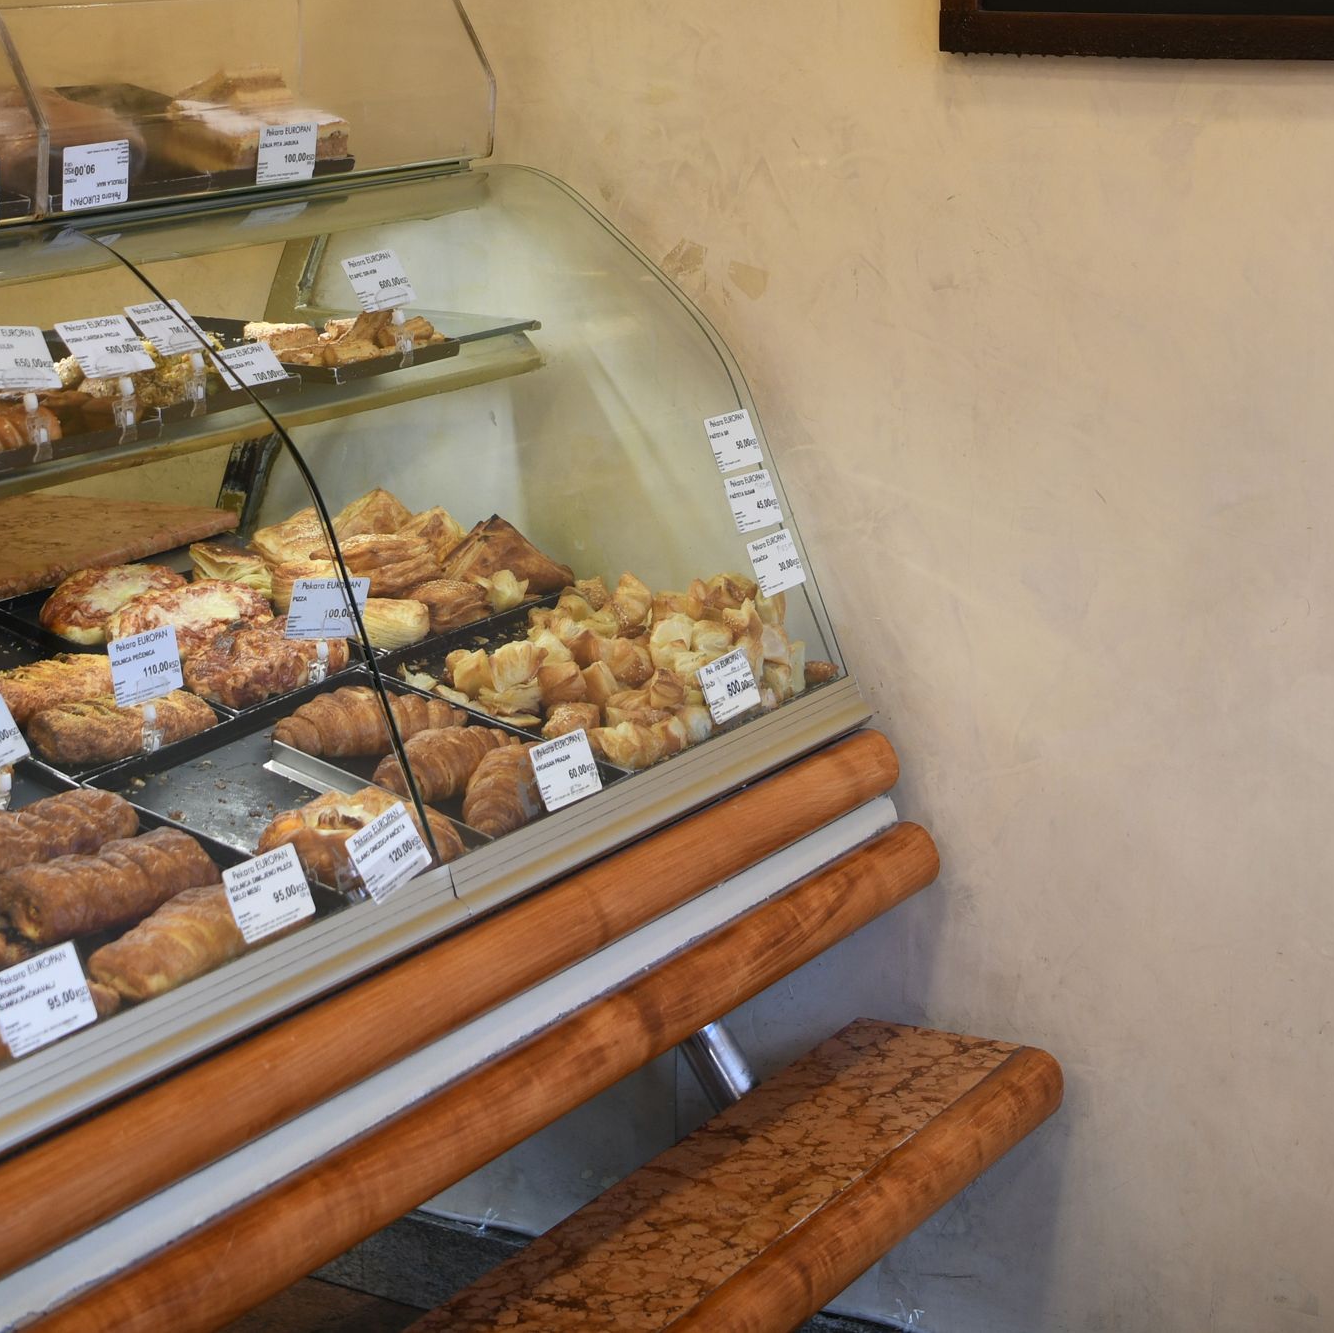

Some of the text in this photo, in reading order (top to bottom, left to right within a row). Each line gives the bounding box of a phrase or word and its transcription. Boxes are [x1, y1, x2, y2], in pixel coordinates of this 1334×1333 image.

[284, 125, 312, 135] EUROPAN
[137, 629, 168, 646] EUROPAN
[371, 808, 400, 834] EUROPAN
[232, 849, 289, 881] Pekara EUROPAN
[233, 885, 262, 903] BELO MESO
[27, 949, 67, 975] EUROPAN
